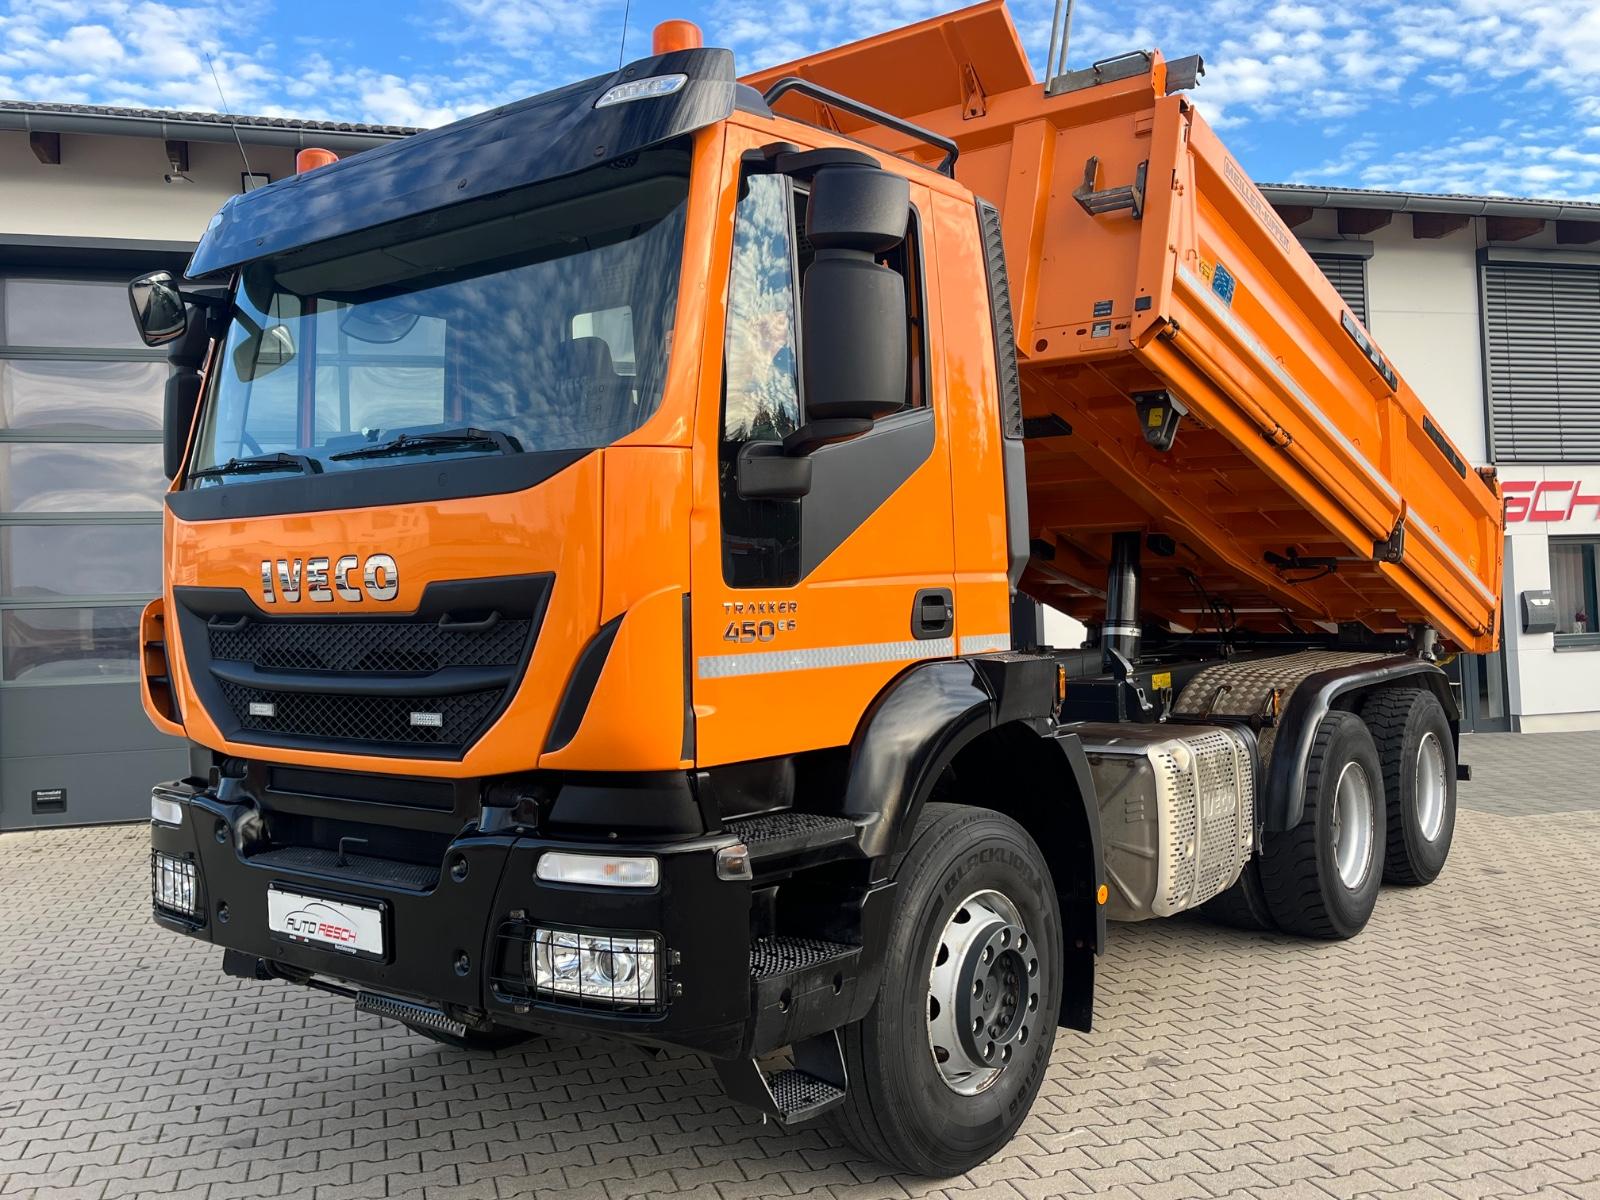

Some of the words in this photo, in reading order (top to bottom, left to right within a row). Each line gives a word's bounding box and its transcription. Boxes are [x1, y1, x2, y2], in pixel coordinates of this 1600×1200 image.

[1225, 162, 1289, 251] MEILLER-KIPPER
[261, 552, 400, 603] IVECO
[722, 601, 798, 615] TRAKKER
[1201, 792, 1236, 819] IVECO
[286, 917, 317, 935] AUTO
[318, 922, 358, 943] RESCH
